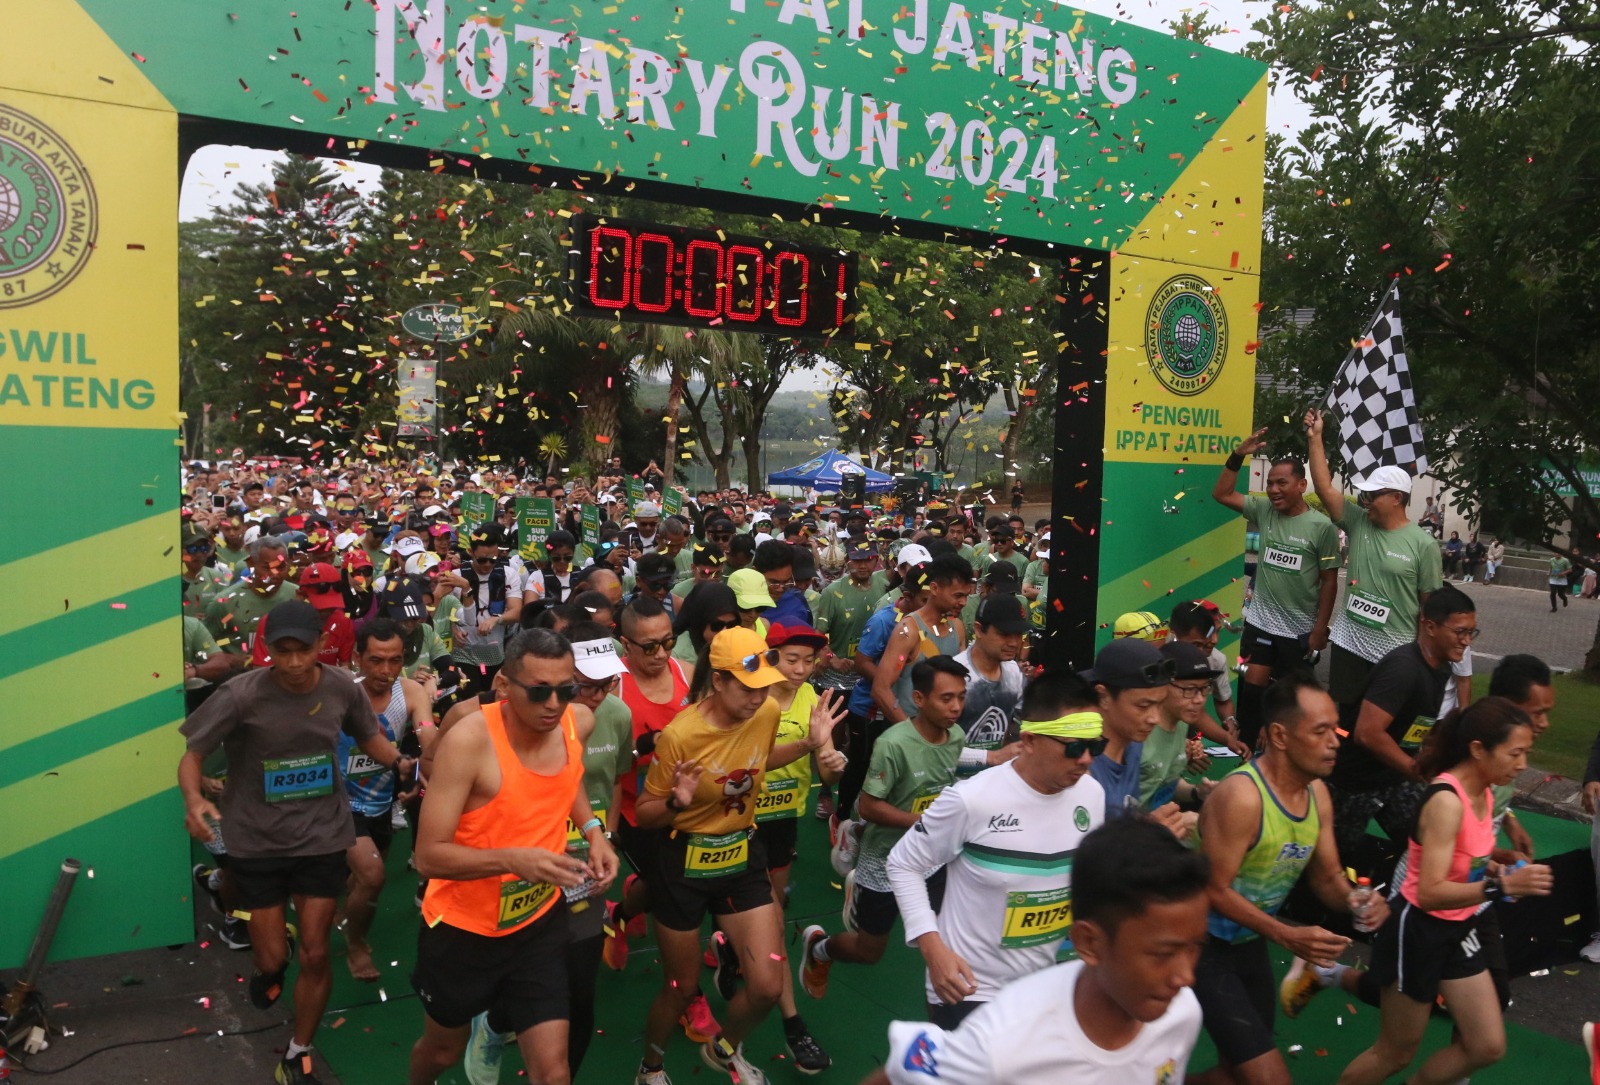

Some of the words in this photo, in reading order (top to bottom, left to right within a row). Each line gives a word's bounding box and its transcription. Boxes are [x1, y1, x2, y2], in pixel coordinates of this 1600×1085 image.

[893, 0, 1137, 104] JATENG
[373, 0, 735, 138] NOTARY
[739, 41, 901, 176] RUN
[924, 110, 1059, 199] 2024
[45, 151, 81, 196] AKTA
[62, 198, 86, 258] TANAH
[589, 227, 845, 327] 00:00:01
[1175, 297, 1203, 313] IPPAT
[1211, 303, 1223, 328] AKTA
[0, 329, 97, 365] WIL
[1214, 329, 1225, 365] TANAH
[0, 373, 156, 411] ATENG
[1169, 377, 1201, 390] 240987
[1141, 403, 1223, 429] PENGWIL
[1116, 429, 1171, 452] IPPAT
[1173, 433, 1243, 455] JATENG
[1269, 551, 1298, 565] N5011
[1351, 598, 1386, 618] R7090
[355, 757, 379, 768] R5
[273, 767, 329, 787] R3034
[755, 792, 793, 808] R2190
[987, 813, 1020, 830] Kala
[698, 844, 743, 864] R2177
[1020, 904, 1071, 928] R1179
